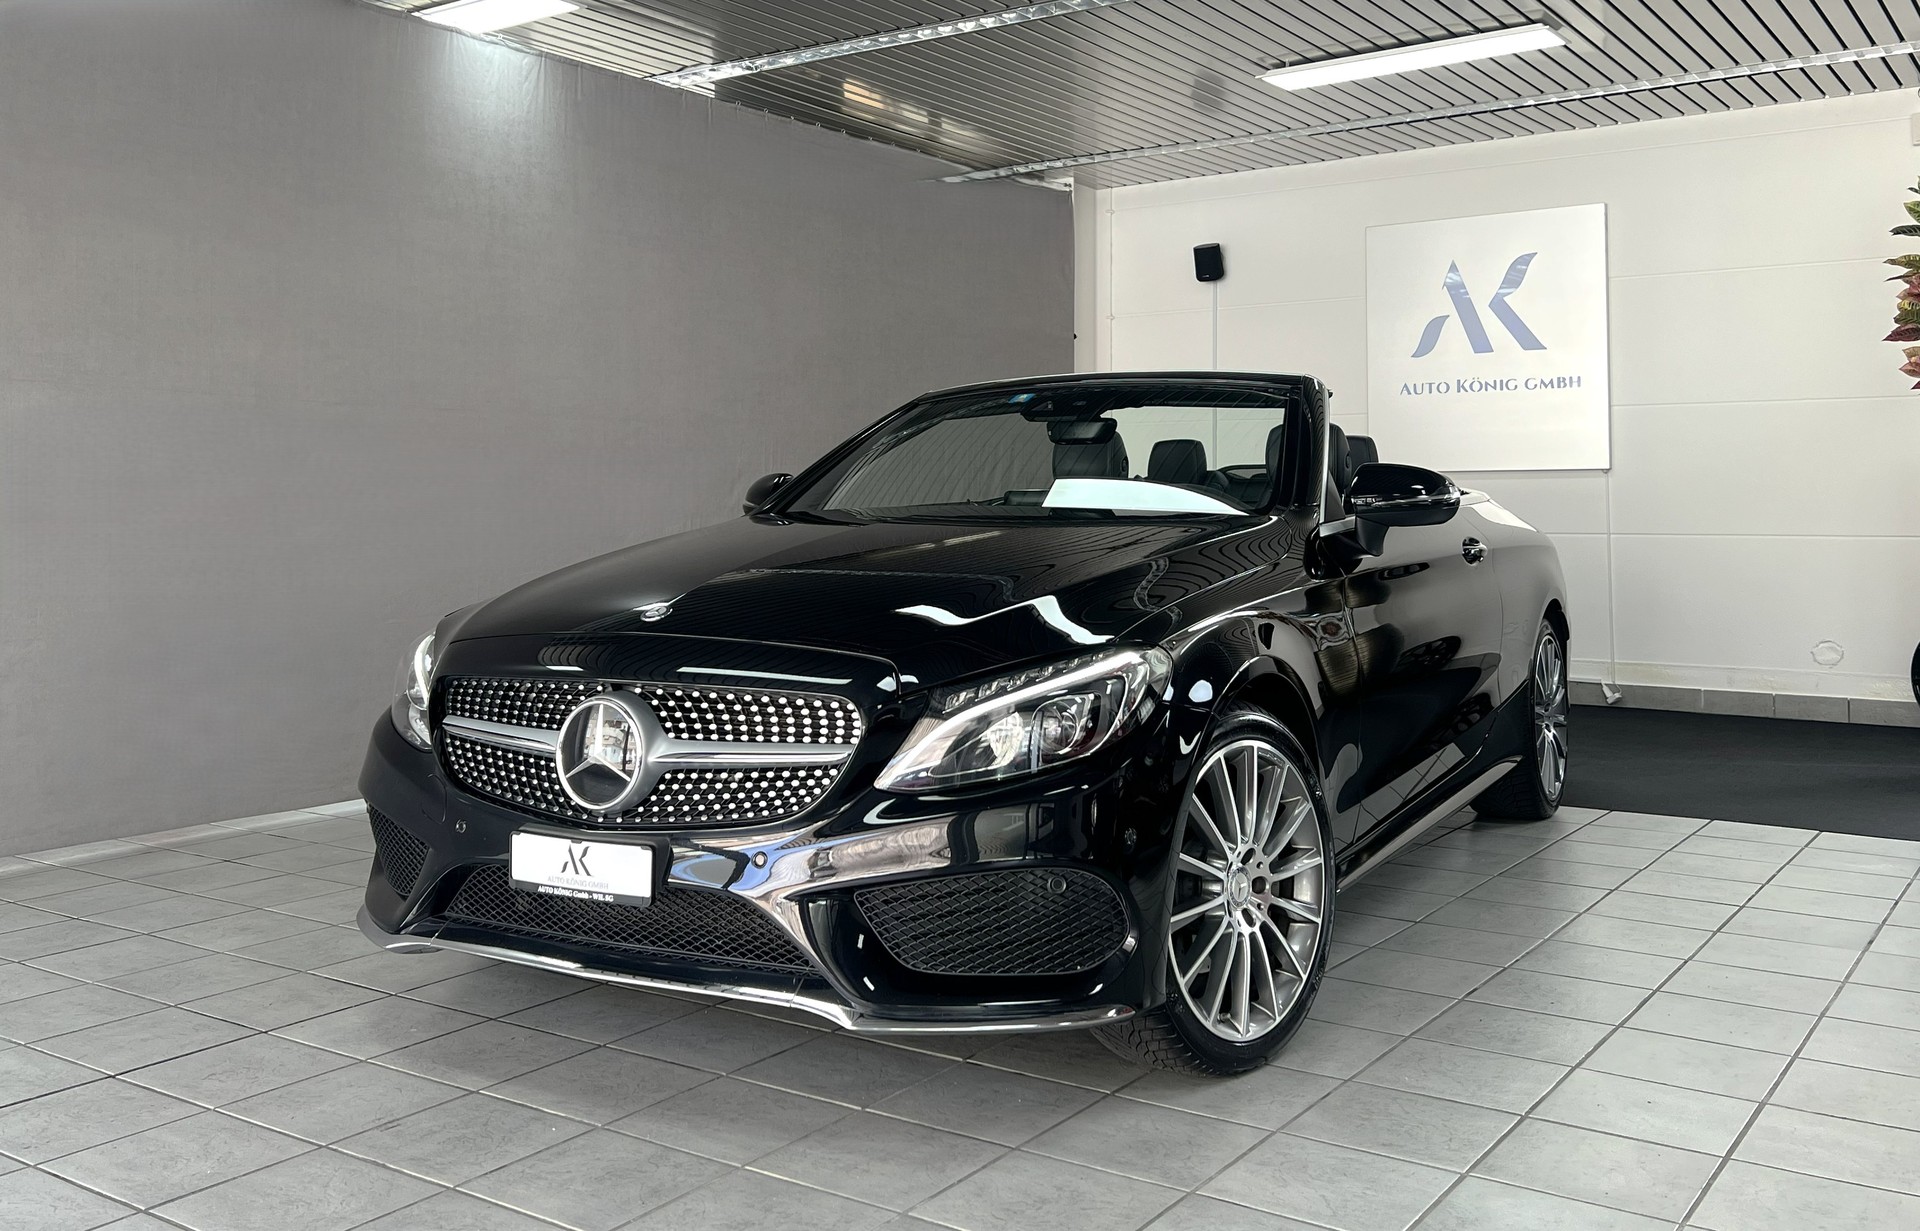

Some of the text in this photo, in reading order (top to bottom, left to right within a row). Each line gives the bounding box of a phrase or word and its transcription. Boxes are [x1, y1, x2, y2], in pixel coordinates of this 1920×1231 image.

[1411, 252, 1547, 358] AK
[1400, 375, 1582, 396] AUTO KÖNIG GMBH
[538, 886, 553, 894] AUTO
[553, 886, 573, 897] KÖNIG
[547, 875, 609, 890] AUTO KÖNIG GMBH
